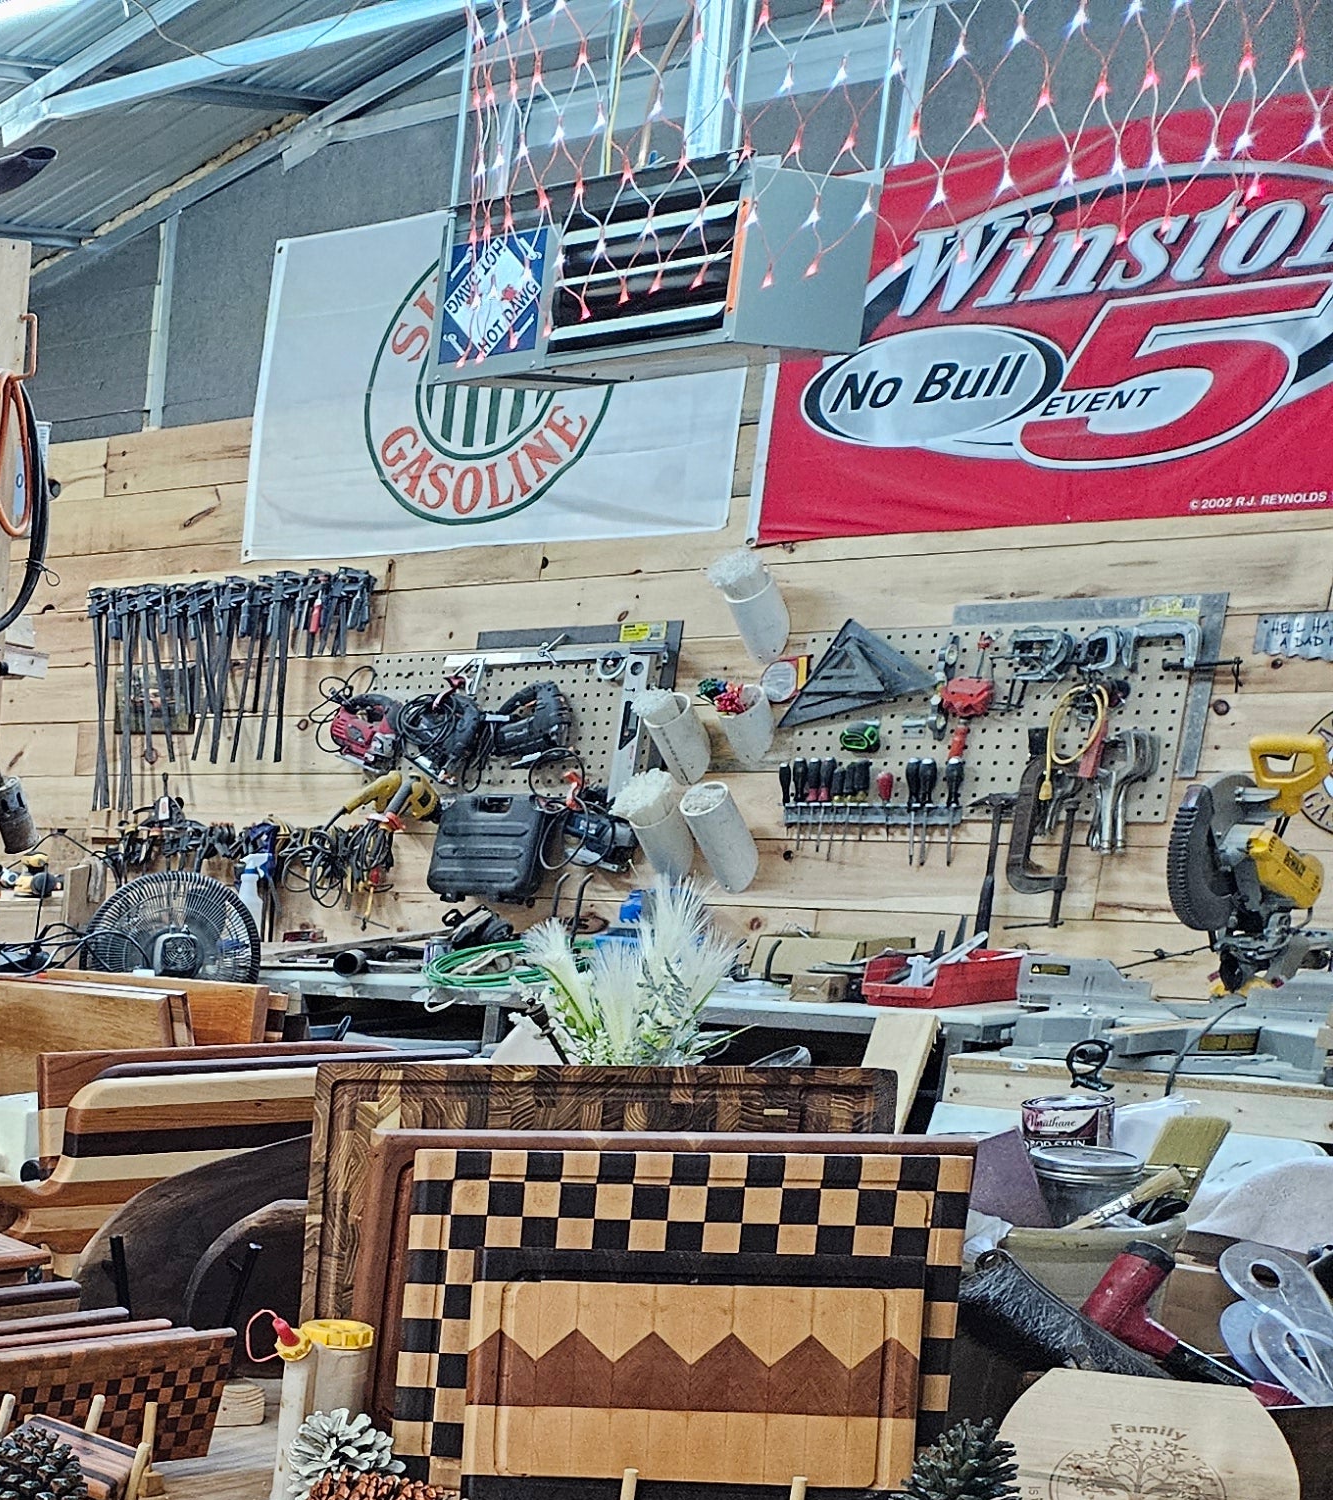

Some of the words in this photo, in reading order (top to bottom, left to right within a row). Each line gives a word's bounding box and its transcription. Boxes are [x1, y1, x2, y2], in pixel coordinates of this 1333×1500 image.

[478, 318, 506, 354] HOT
[503, 280, 540, 325] DAWG
[829, 371, 904, 415] No
[913, 352, 1030, 405] Bull
[1040, 386, 1160, 418] EVENT
[381, 405, 588, 516] GASOLINE
[1201, 498, 1233, 510] 2002
[1235, 496, 1257, 507] R.J.
[1261, 490, 1328, 505] REYNOLDS
[1313, 617, 1333, 634] HA
[1295, 636, 1324, 648] DAD
[1110, 1423, 1189, 1442] Family
[1028, 1486, 1042, 1496] Is
